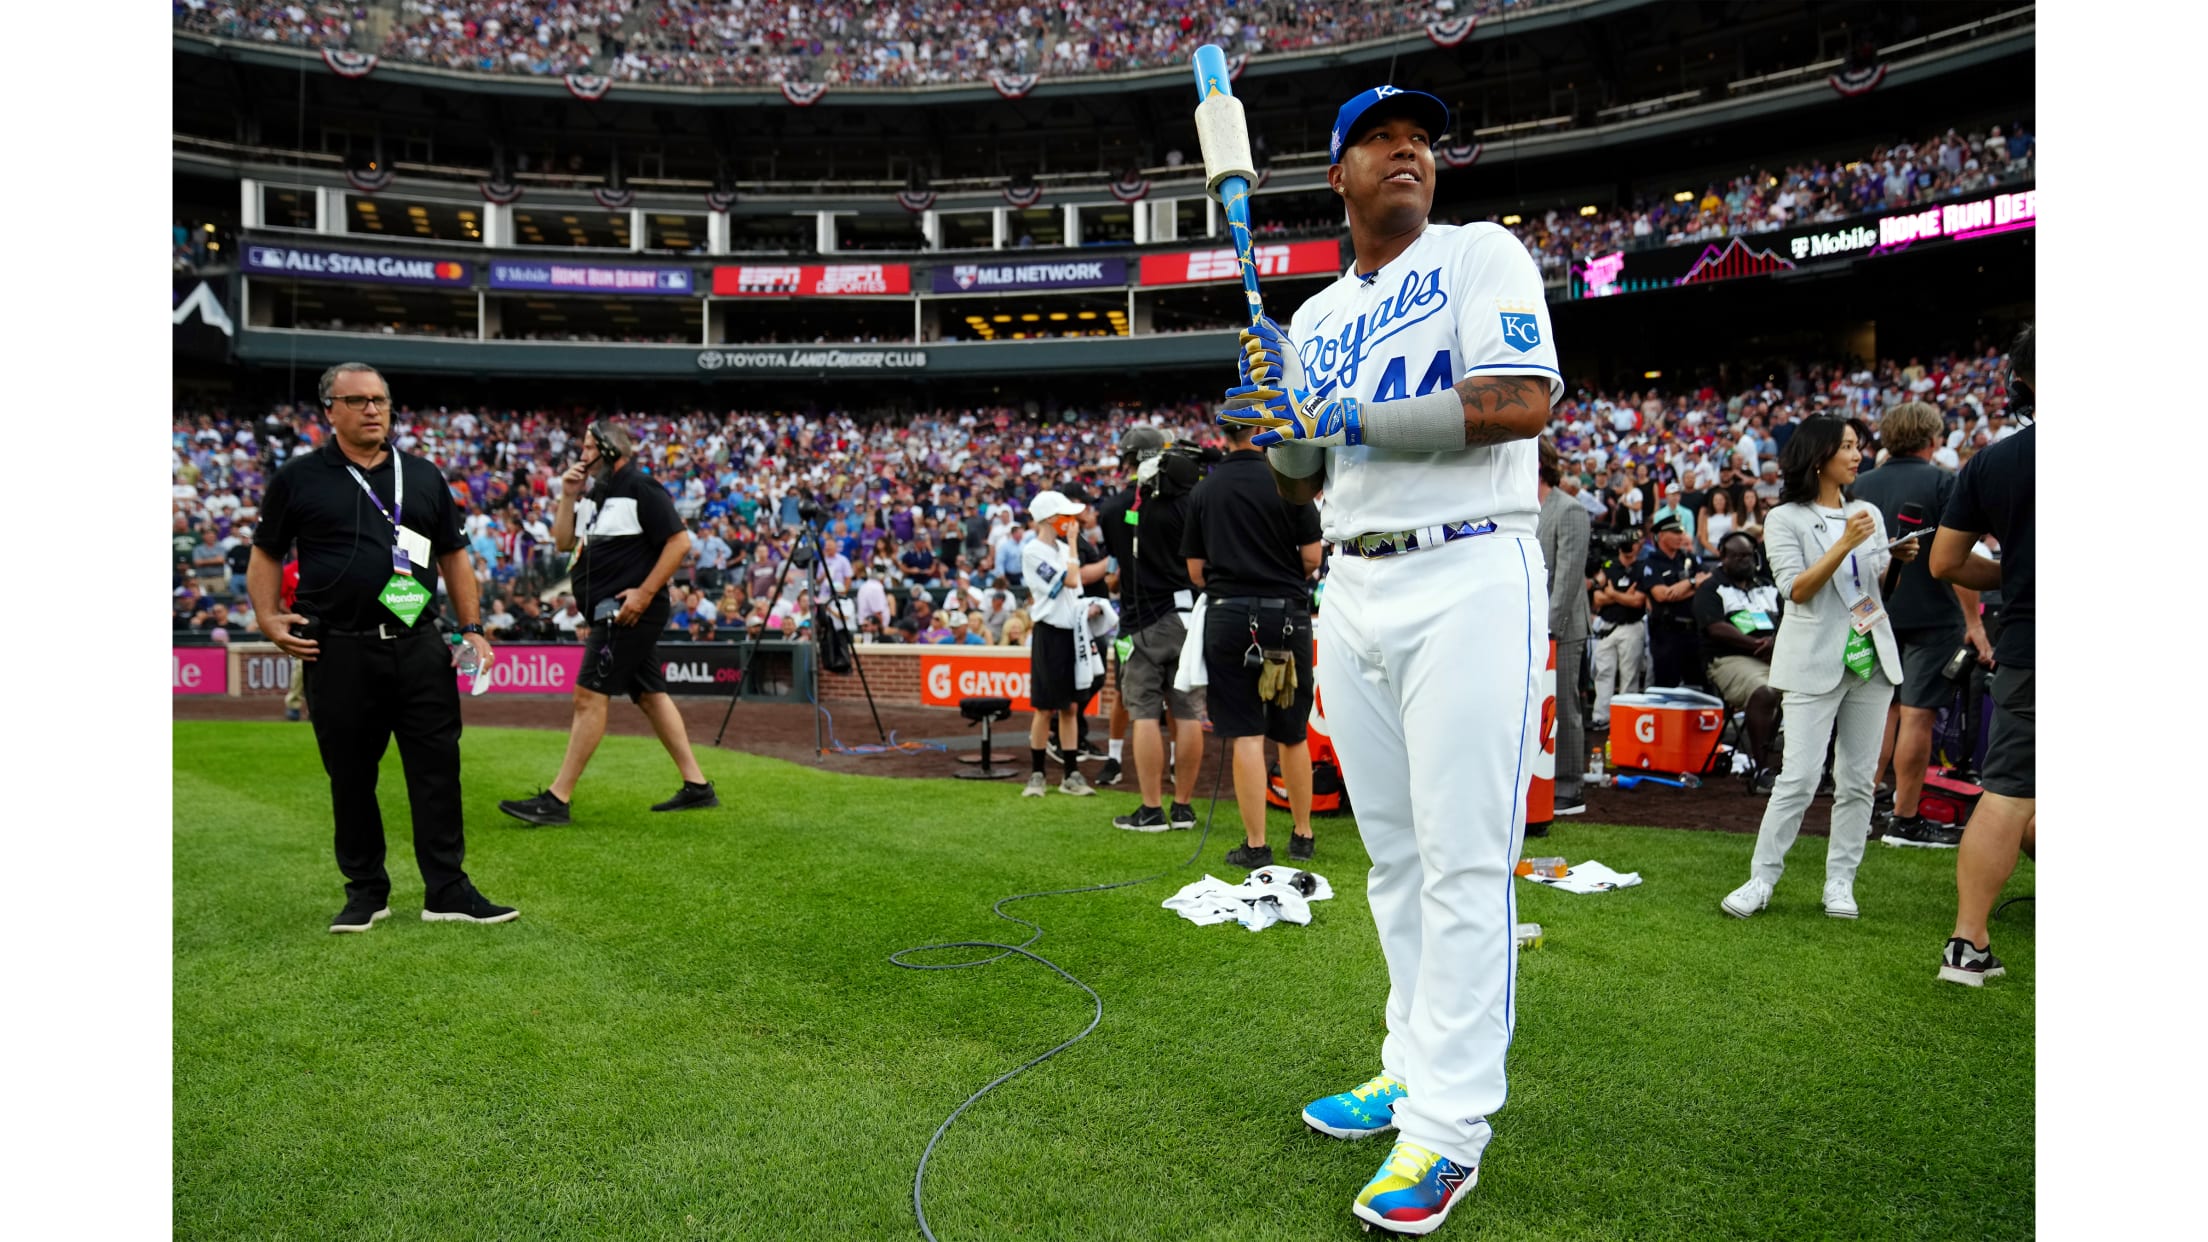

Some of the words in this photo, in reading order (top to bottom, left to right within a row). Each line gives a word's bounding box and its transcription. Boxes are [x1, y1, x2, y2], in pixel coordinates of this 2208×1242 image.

[1374, 85, 1404, 100] K
[1811, 225, 1877, 256] Mobile
[1879, 209, 1941, 247] HOME
[1943, 199, 1993, 235] RUN
[378, 256, 435, 279] GAME
[508, 266, 549, 283] Mobile
[551, 266, 586, 286] HOME
[588, 267, 614, 287] RUN
[615, 268, 657, 288] DERBY
[738, 266, 801, 284] ESPN
[823, 265, 883, 282] ESPN
[978, 268, 1014, 285] MLB
[1015, 262, 1103, 283] NETWORK
[816, 279, 887, 293] DEPORTES
[1300, 267, 1448, 388] Royals
[1502, 316, 1538, 343] KC
[725, 352, 787, 367] TOYOTA
[789, 350, 826, 367] LAND
[827, 350, 885, 368] CRUISER
[885, 352, 926, 367] CLUB
[1372, 350, 1454, 402] 44
[385, 591, 424, 604] Monday
[468, 654, 565, 687] obile
[928, 664, 951, 699] G
[1635, 714, 1655, 743] G
